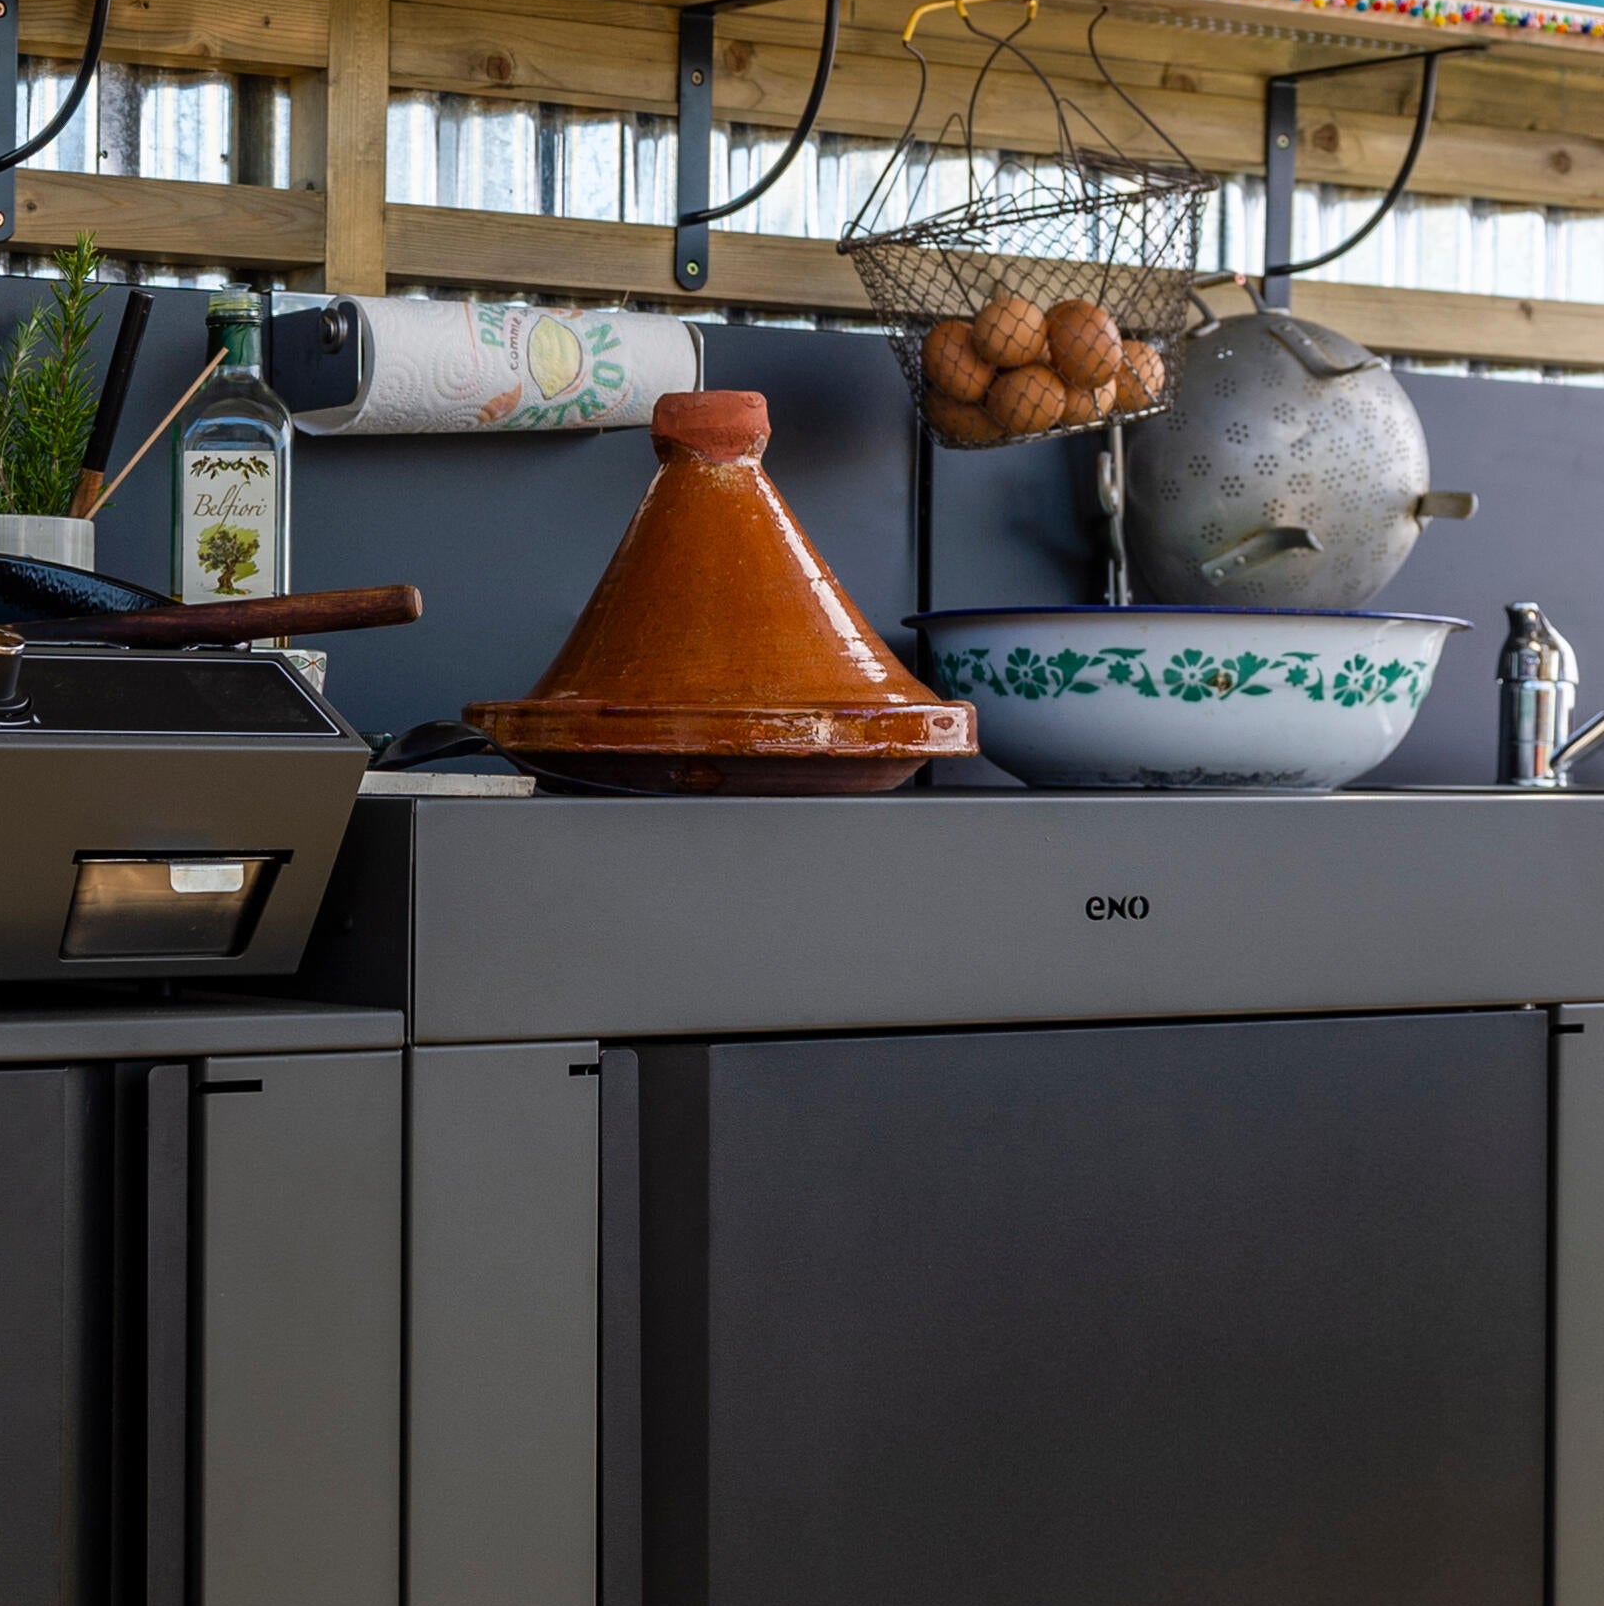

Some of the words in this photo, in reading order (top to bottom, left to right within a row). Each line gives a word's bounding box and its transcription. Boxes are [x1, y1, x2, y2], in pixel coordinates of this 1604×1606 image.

[502, 322, 624, 429] CITRON
[509, 317, 523, 371] comme
[193, 480, 268, 543] Belfiori
